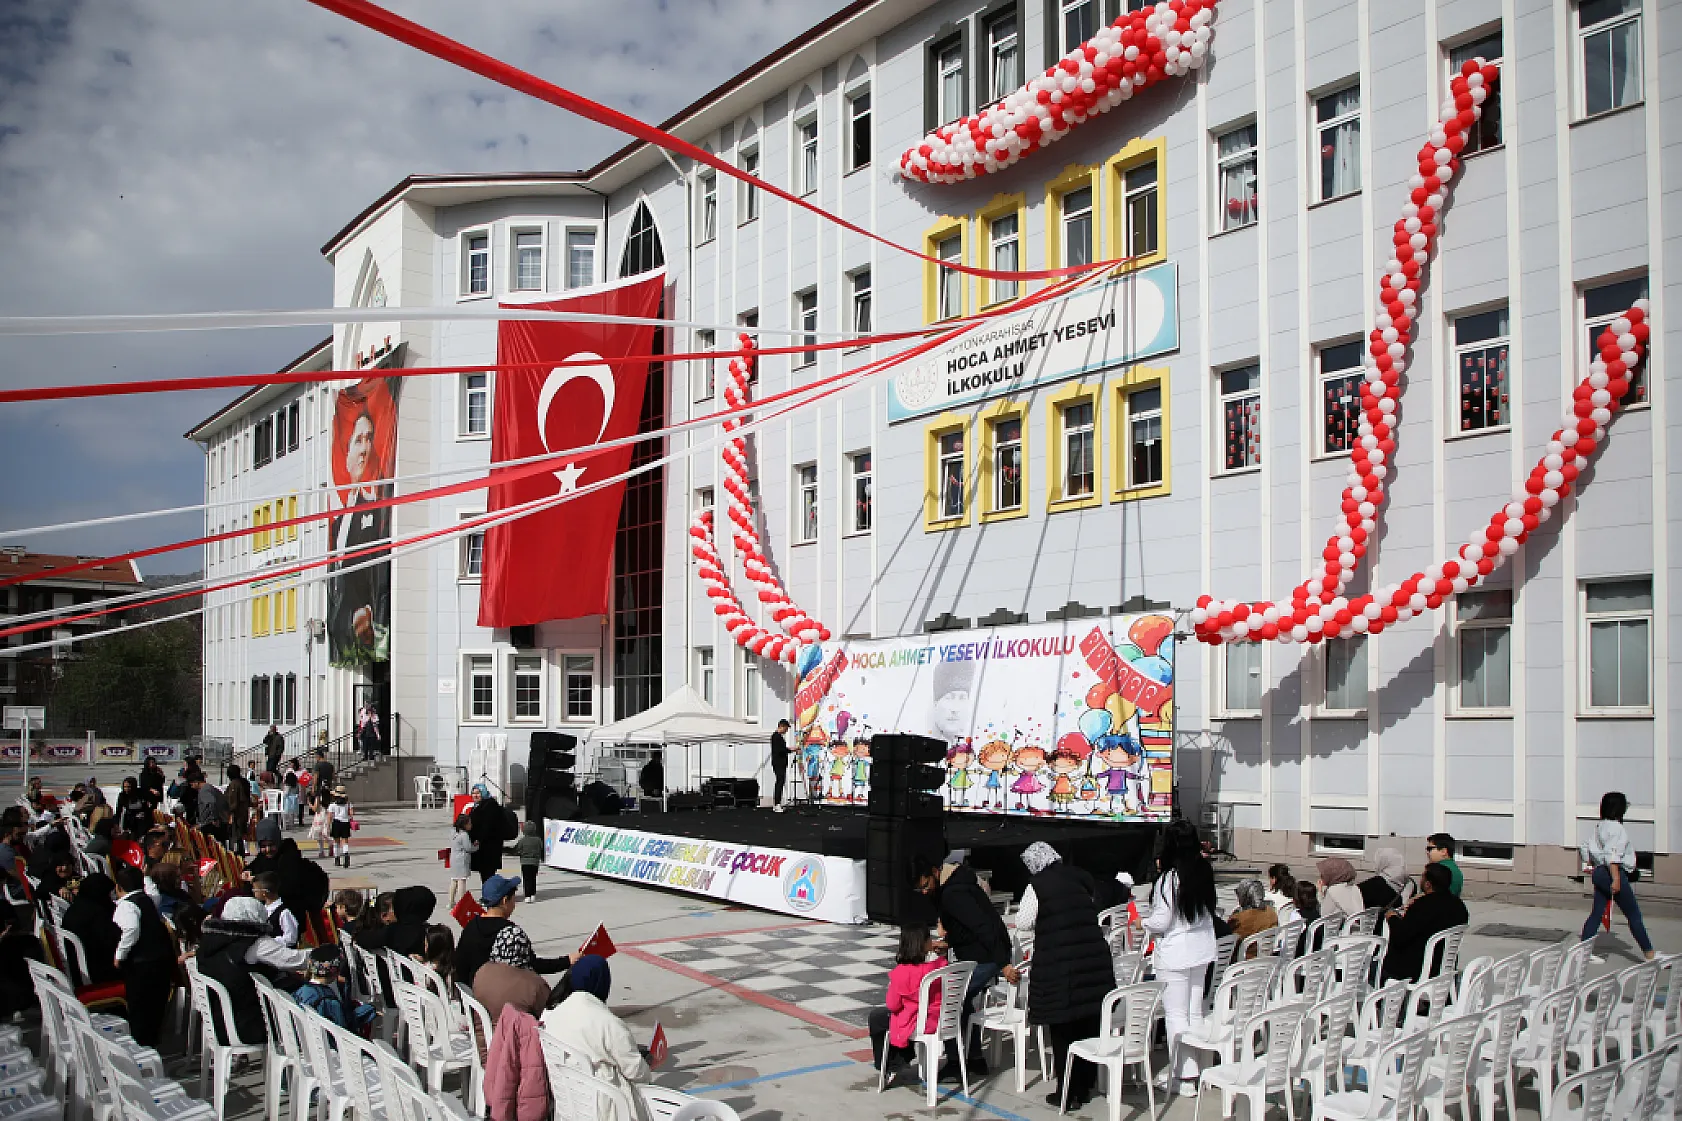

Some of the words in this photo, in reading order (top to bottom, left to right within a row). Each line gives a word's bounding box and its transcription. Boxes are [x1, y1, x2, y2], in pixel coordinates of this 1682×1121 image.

[947, 350, 988, 374] HOCA
[993, 332, 1048, 361] AHMET
[1053, 309, 1116, 343] YESEVİ
[947, 362, 1024, 396] İLKOKULU
[850, 650, 886, 669] HOCA
[888, 646, 935, 667] AHMET
[939, 636, 990, 662] YESEVİ
[991, 635, 1075, 659] İLKOKULU
[630, 859, 672, 884] KUTLU
[669, 865, 716, 891] OLSUN
[711, 848, 735, 868] VE
[729, 852, 787, 878] ÇOCUK
